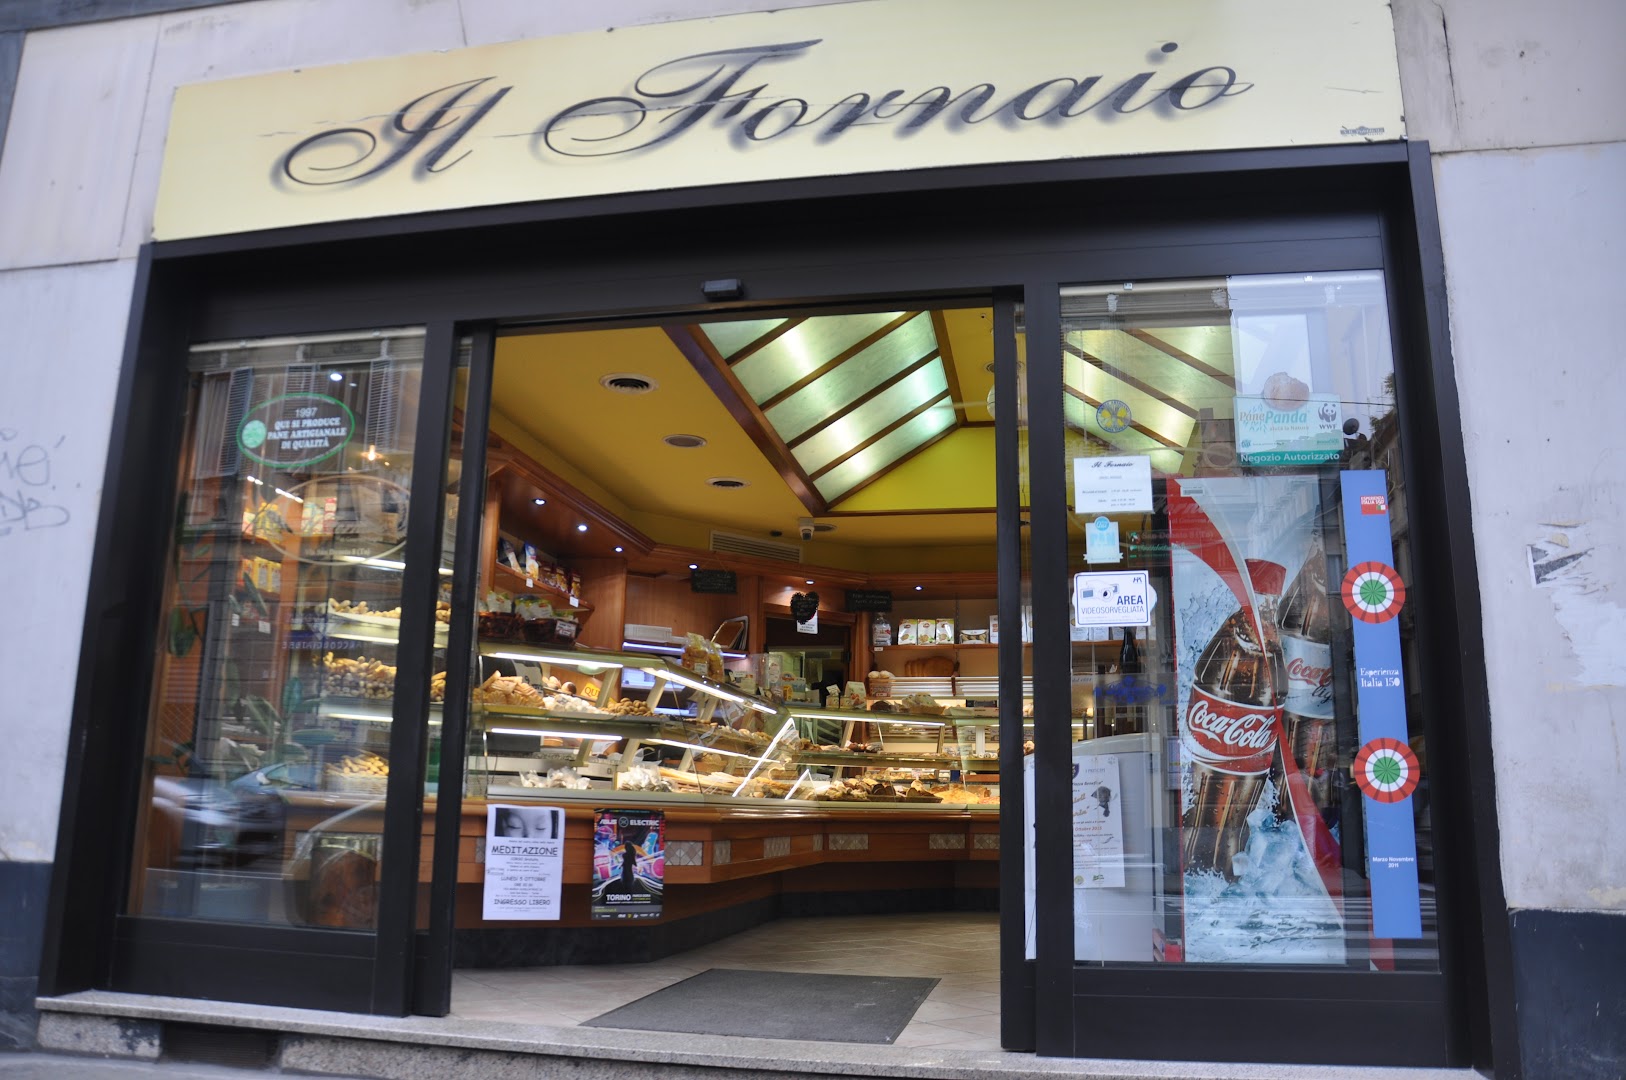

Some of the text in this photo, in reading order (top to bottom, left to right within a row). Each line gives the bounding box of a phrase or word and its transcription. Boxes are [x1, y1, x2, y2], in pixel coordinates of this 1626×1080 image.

[284, 39, 1254, 186] Il Fornaio
[296, 407, 318, 418] 1997
[274, 417, 341, 430] QUI SI PRODUCE
[267, 427, 347, 440] PANE ARTIGIANALE
[281, 440, 291, 449] DI
[1240, 453, 1340, 463] Negozio Autorizzato
[1104, 460, 1134, 468] Fornaio
[1117, 595, 1144, 605] AREA
[1081, 605, 1145, 615] VIDEOSORVEGLIATA
[1360, 667, 1399, 678] Esperienza
[1361, 677, 1400, 687] Italia 150
[1188, 700, 1276, 749] Coca-Cola
[491, 845, 559, 856] MEDITAZIONE
